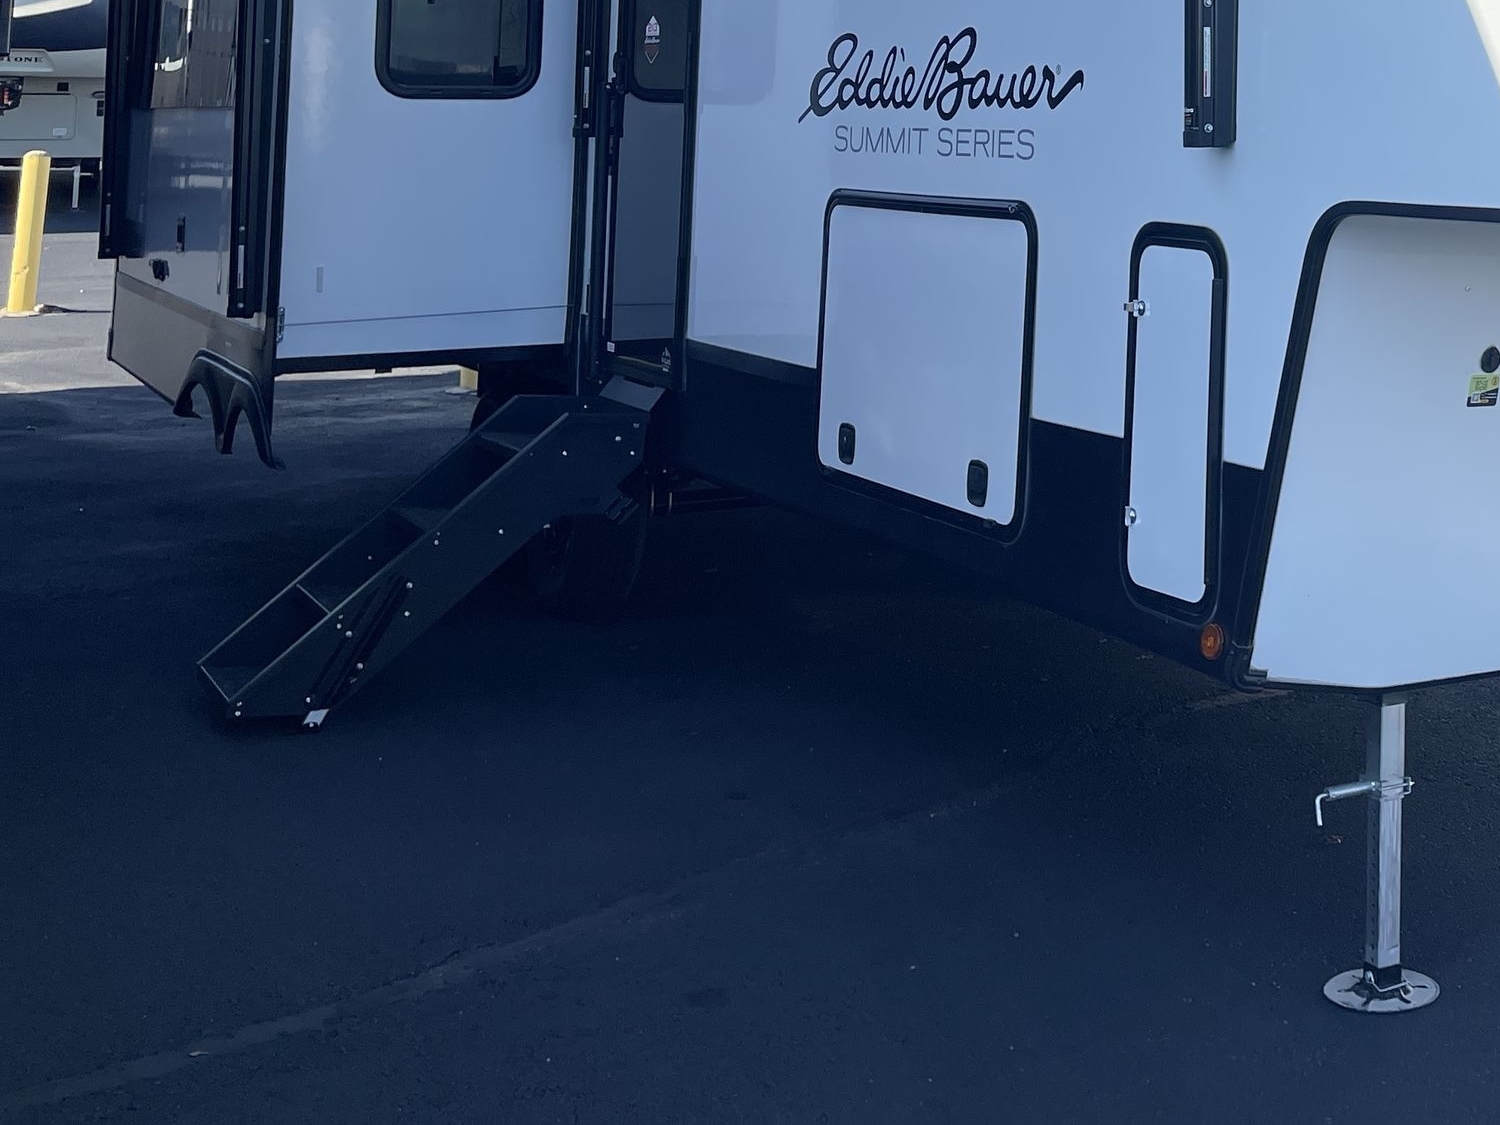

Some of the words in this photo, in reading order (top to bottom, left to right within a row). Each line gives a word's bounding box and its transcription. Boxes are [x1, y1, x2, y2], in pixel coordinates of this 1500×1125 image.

[797, 32, 918, 124] Eddie
[922, 26, 1085, 121] Bauer
[833, 125, 930, 155] SUMMIT
[936, 127, 1036, 161] SERIES
